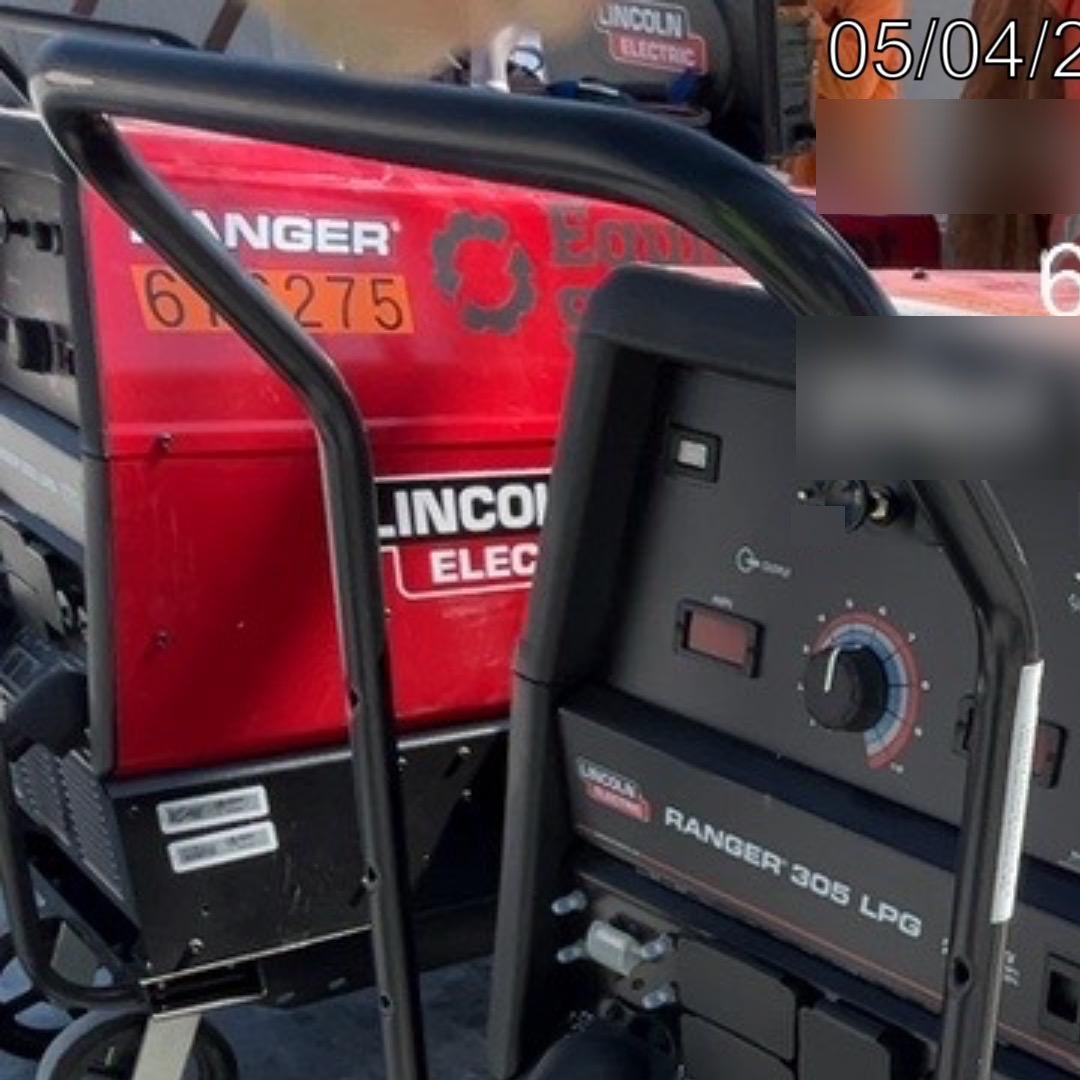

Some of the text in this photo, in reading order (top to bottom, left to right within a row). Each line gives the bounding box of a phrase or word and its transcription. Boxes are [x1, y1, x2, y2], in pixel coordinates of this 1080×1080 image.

[130, 209, 391, 256] NGER
[144, 268, 404, 331] 6275
[664, 805, 783, 877] RANGER
[789, 863, 850, 908] 305
[858, 893, 923, 939] LPG
